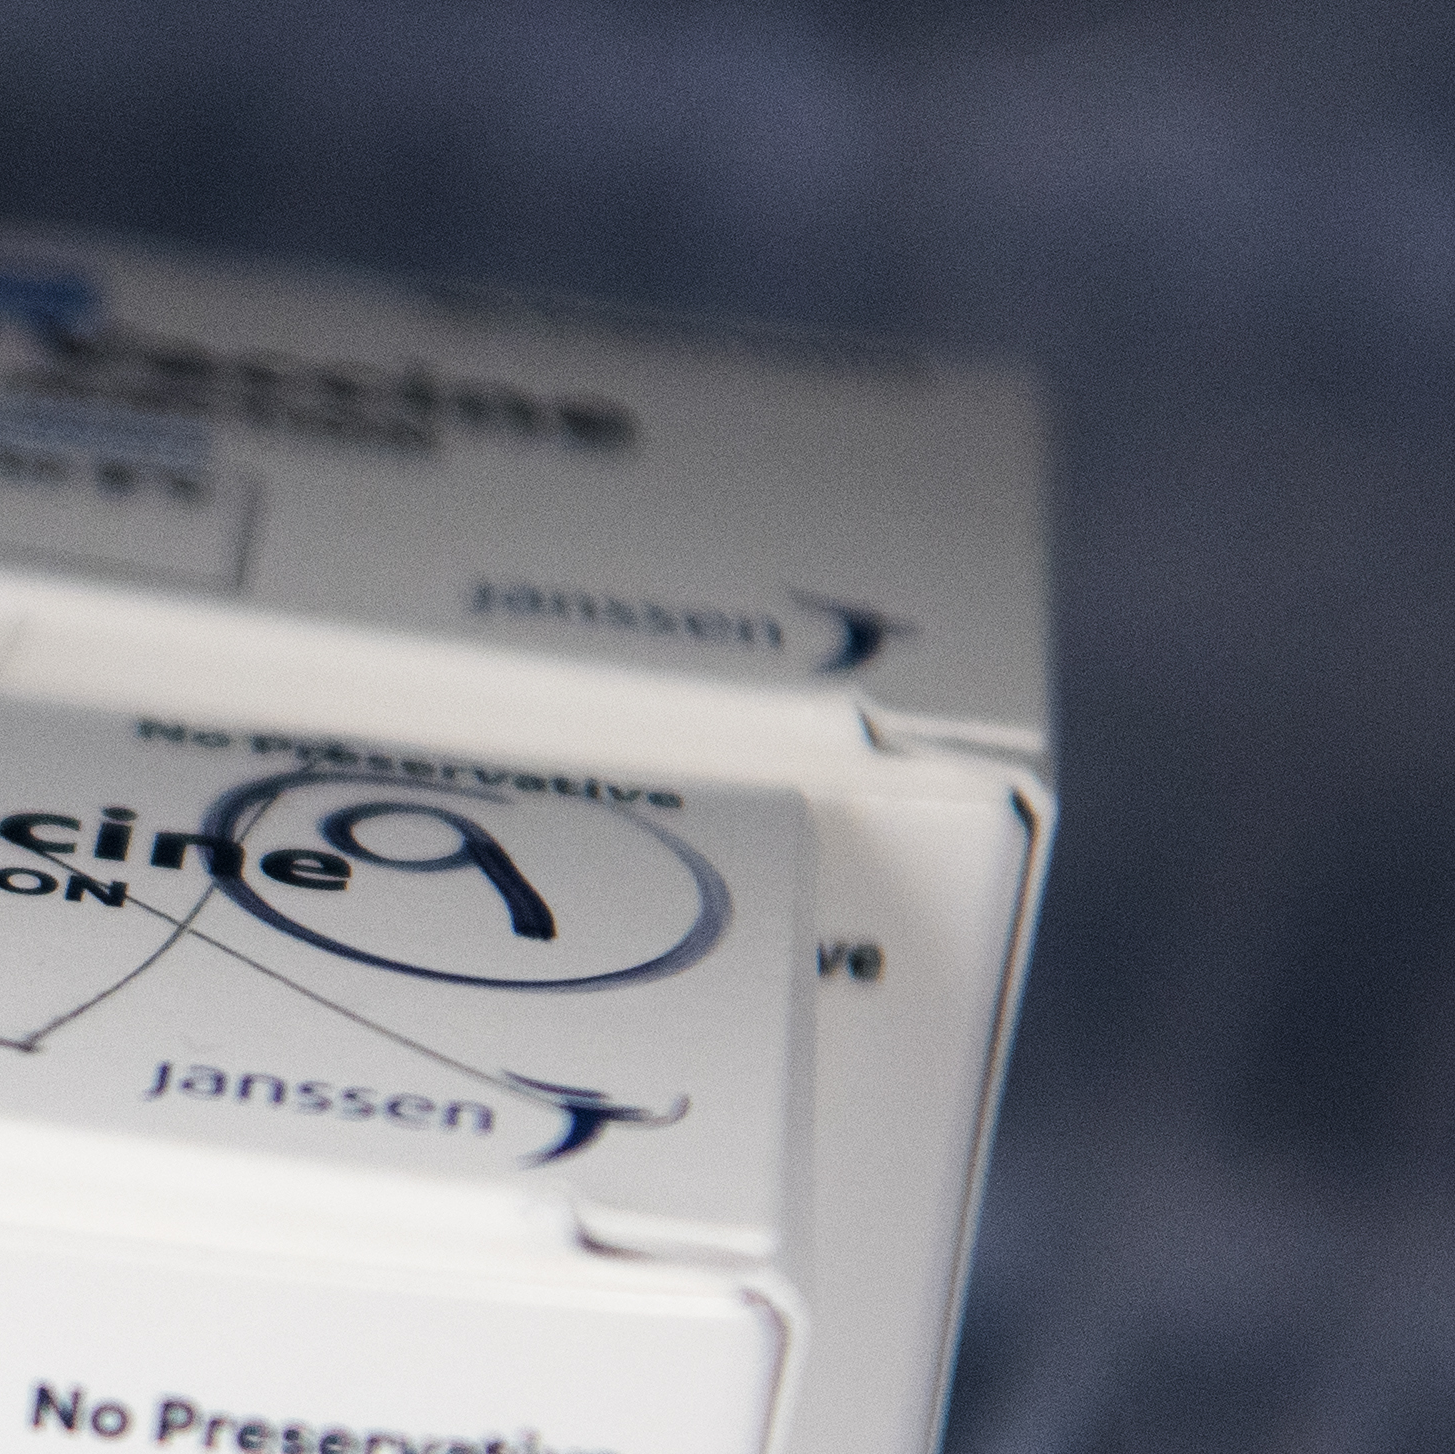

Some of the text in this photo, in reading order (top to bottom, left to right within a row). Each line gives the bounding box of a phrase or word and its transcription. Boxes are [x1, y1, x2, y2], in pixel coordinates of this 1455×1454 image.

[136, 716, 686, 810] No Preservative
[145, 1058, 494, 1135] janssen
[28, 1382, 131, 1442] No
